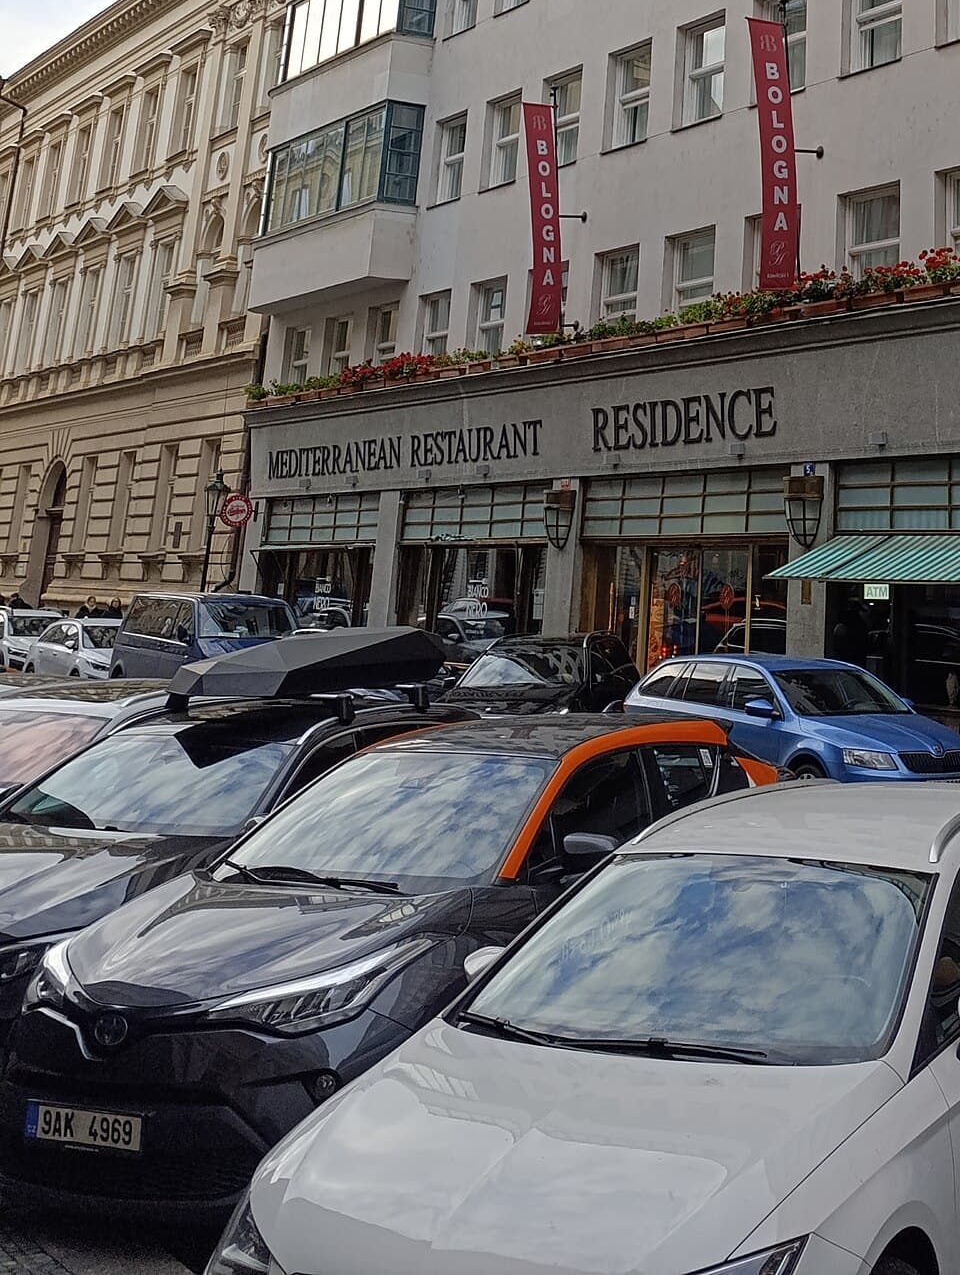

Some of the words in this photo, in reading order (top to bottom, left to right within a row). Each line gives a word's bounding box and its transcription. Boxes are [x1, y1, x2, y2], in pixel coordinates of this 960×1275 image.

[765, 62, 789, 231] BOLOGNA
[536, 139, 555, 286] BOLOGNA
[268, 435, 401, 480] MEDITERRANEAN
[410, 419, 543, 467] RESTAURANT
[591, 386, 778, 452] RESIDENCE
[866, 586, 888, 598] ATM
[41, 1110, 74, 1138] 9AK
[88, 1115, 133, 1146] 4969
